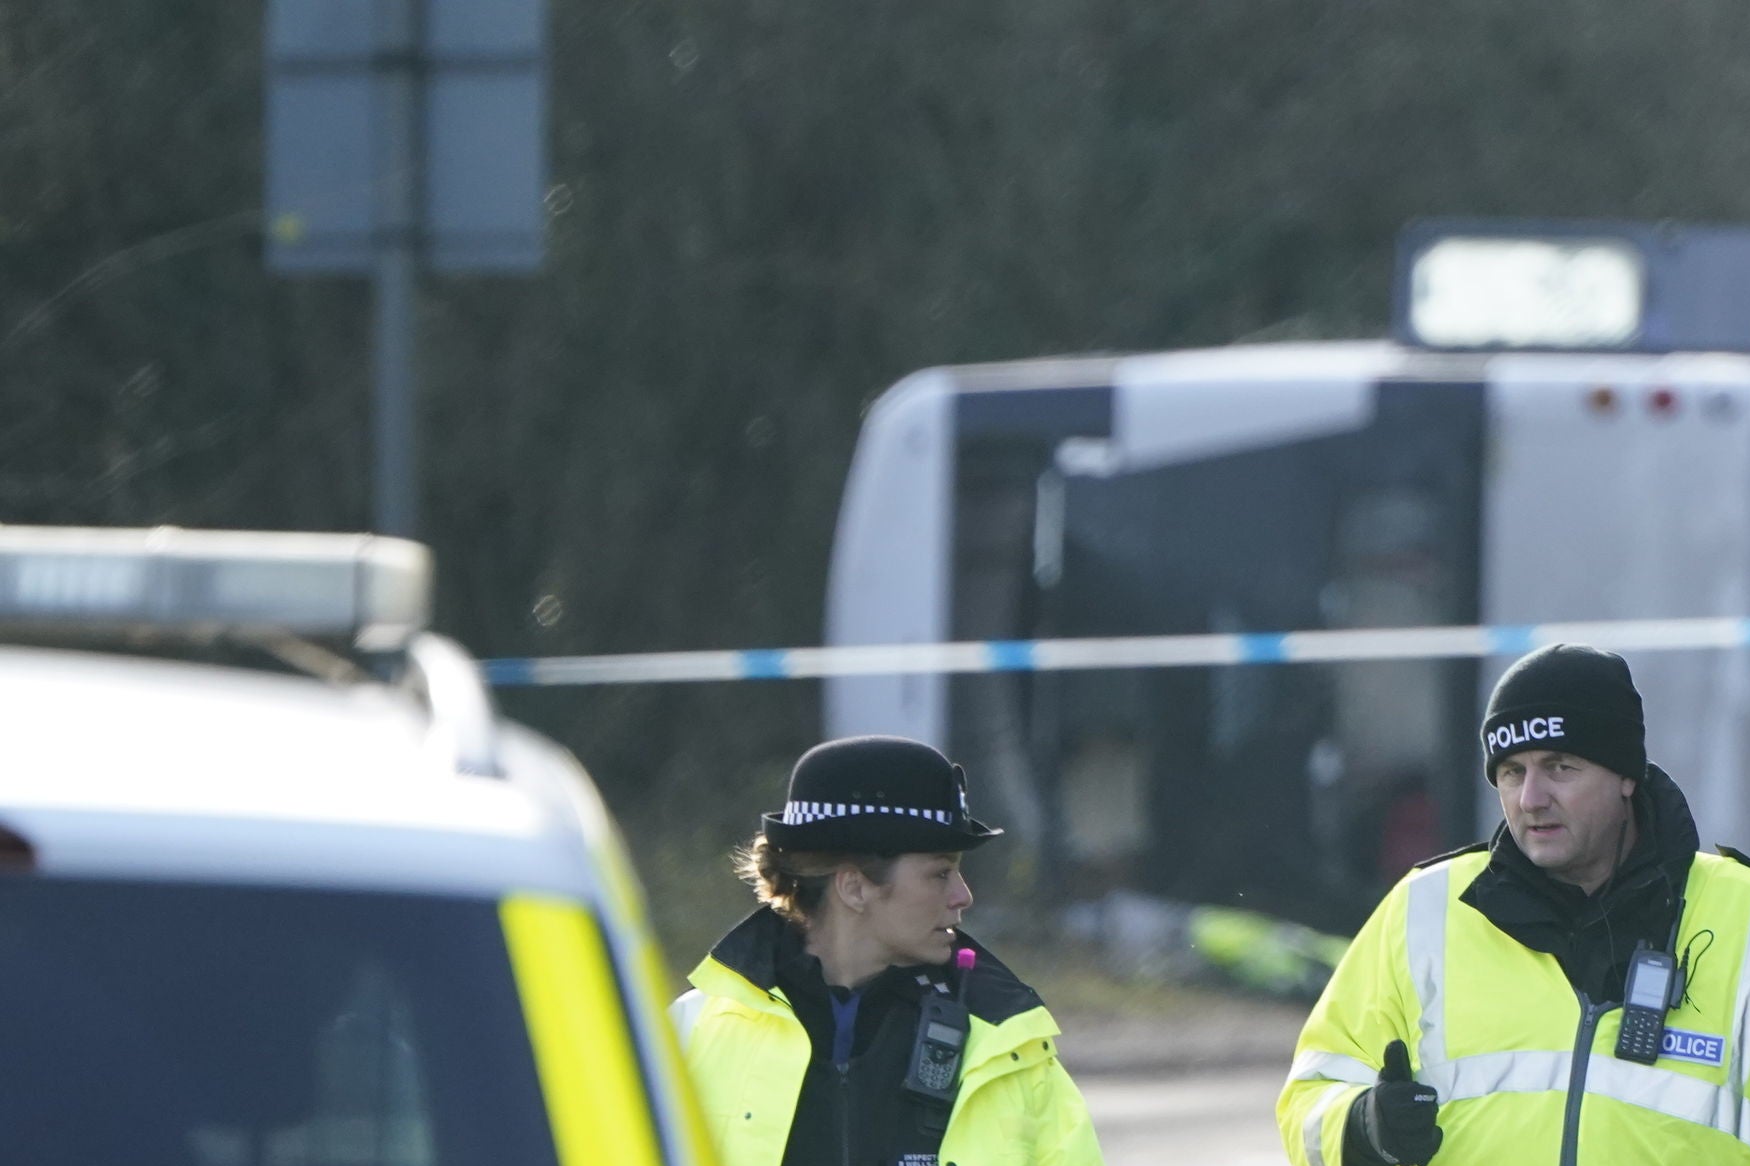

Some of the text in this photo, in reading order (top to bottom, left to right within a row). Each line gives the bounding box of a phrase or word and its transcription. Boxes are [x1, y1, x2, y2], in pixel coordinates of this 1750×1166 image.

[1487, 717, 1565, 755] POLICE
[1662, 1033, 1719, 1059] OLICE
[903, 1153, 938, 1161] INSPECT
